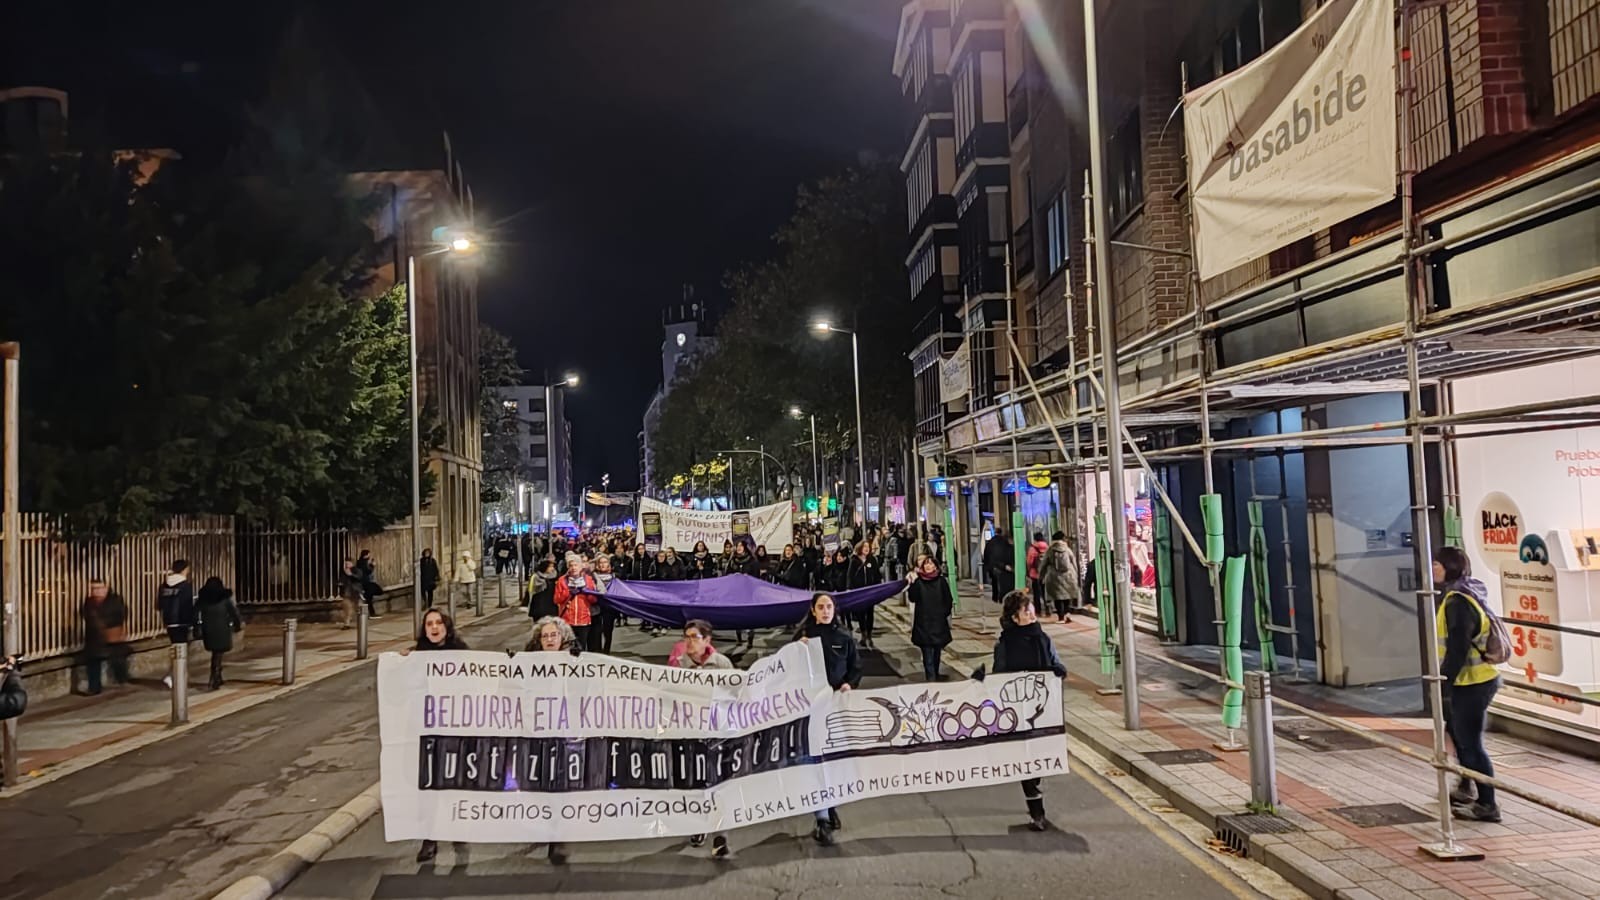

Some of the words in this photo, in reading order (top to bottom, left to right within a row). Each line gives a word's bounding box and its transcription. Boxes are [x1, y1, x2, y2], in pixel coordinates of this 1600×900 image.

[1229, 70, 1367, 181] basabide
[1481, 510, 1517, 530] BLACK
[1483, 527, 1518, 545] FRIDAY
[1519, 594, 1538, 611] GB
[426, 662, 525, 680] INDARKERIA
[530, 663, 652, 682] MATXISTAREN
[658, 669, 743, 687] AURKAKO
[746, 659, 785, 686] EGINA
[424, 694, 524, 730] BELDURRA
[533, 696, 570, 732] ETA
[727, 688, 811, 729] AURREAN
[424, 741, 581, 788] justizia
[611, 725, 796, 781] feminista!
[734, 796, 796, 823] EUSKAL
[801, 779, 865, 808] HERRIKO
[869, 768, 966, 790] MUGIMENDU
[971, 757, 1063, 780] FEMINISTA
[451, 799, 552, 821] ¡Estamos
[560, 792, 718, 823] organizadas!
